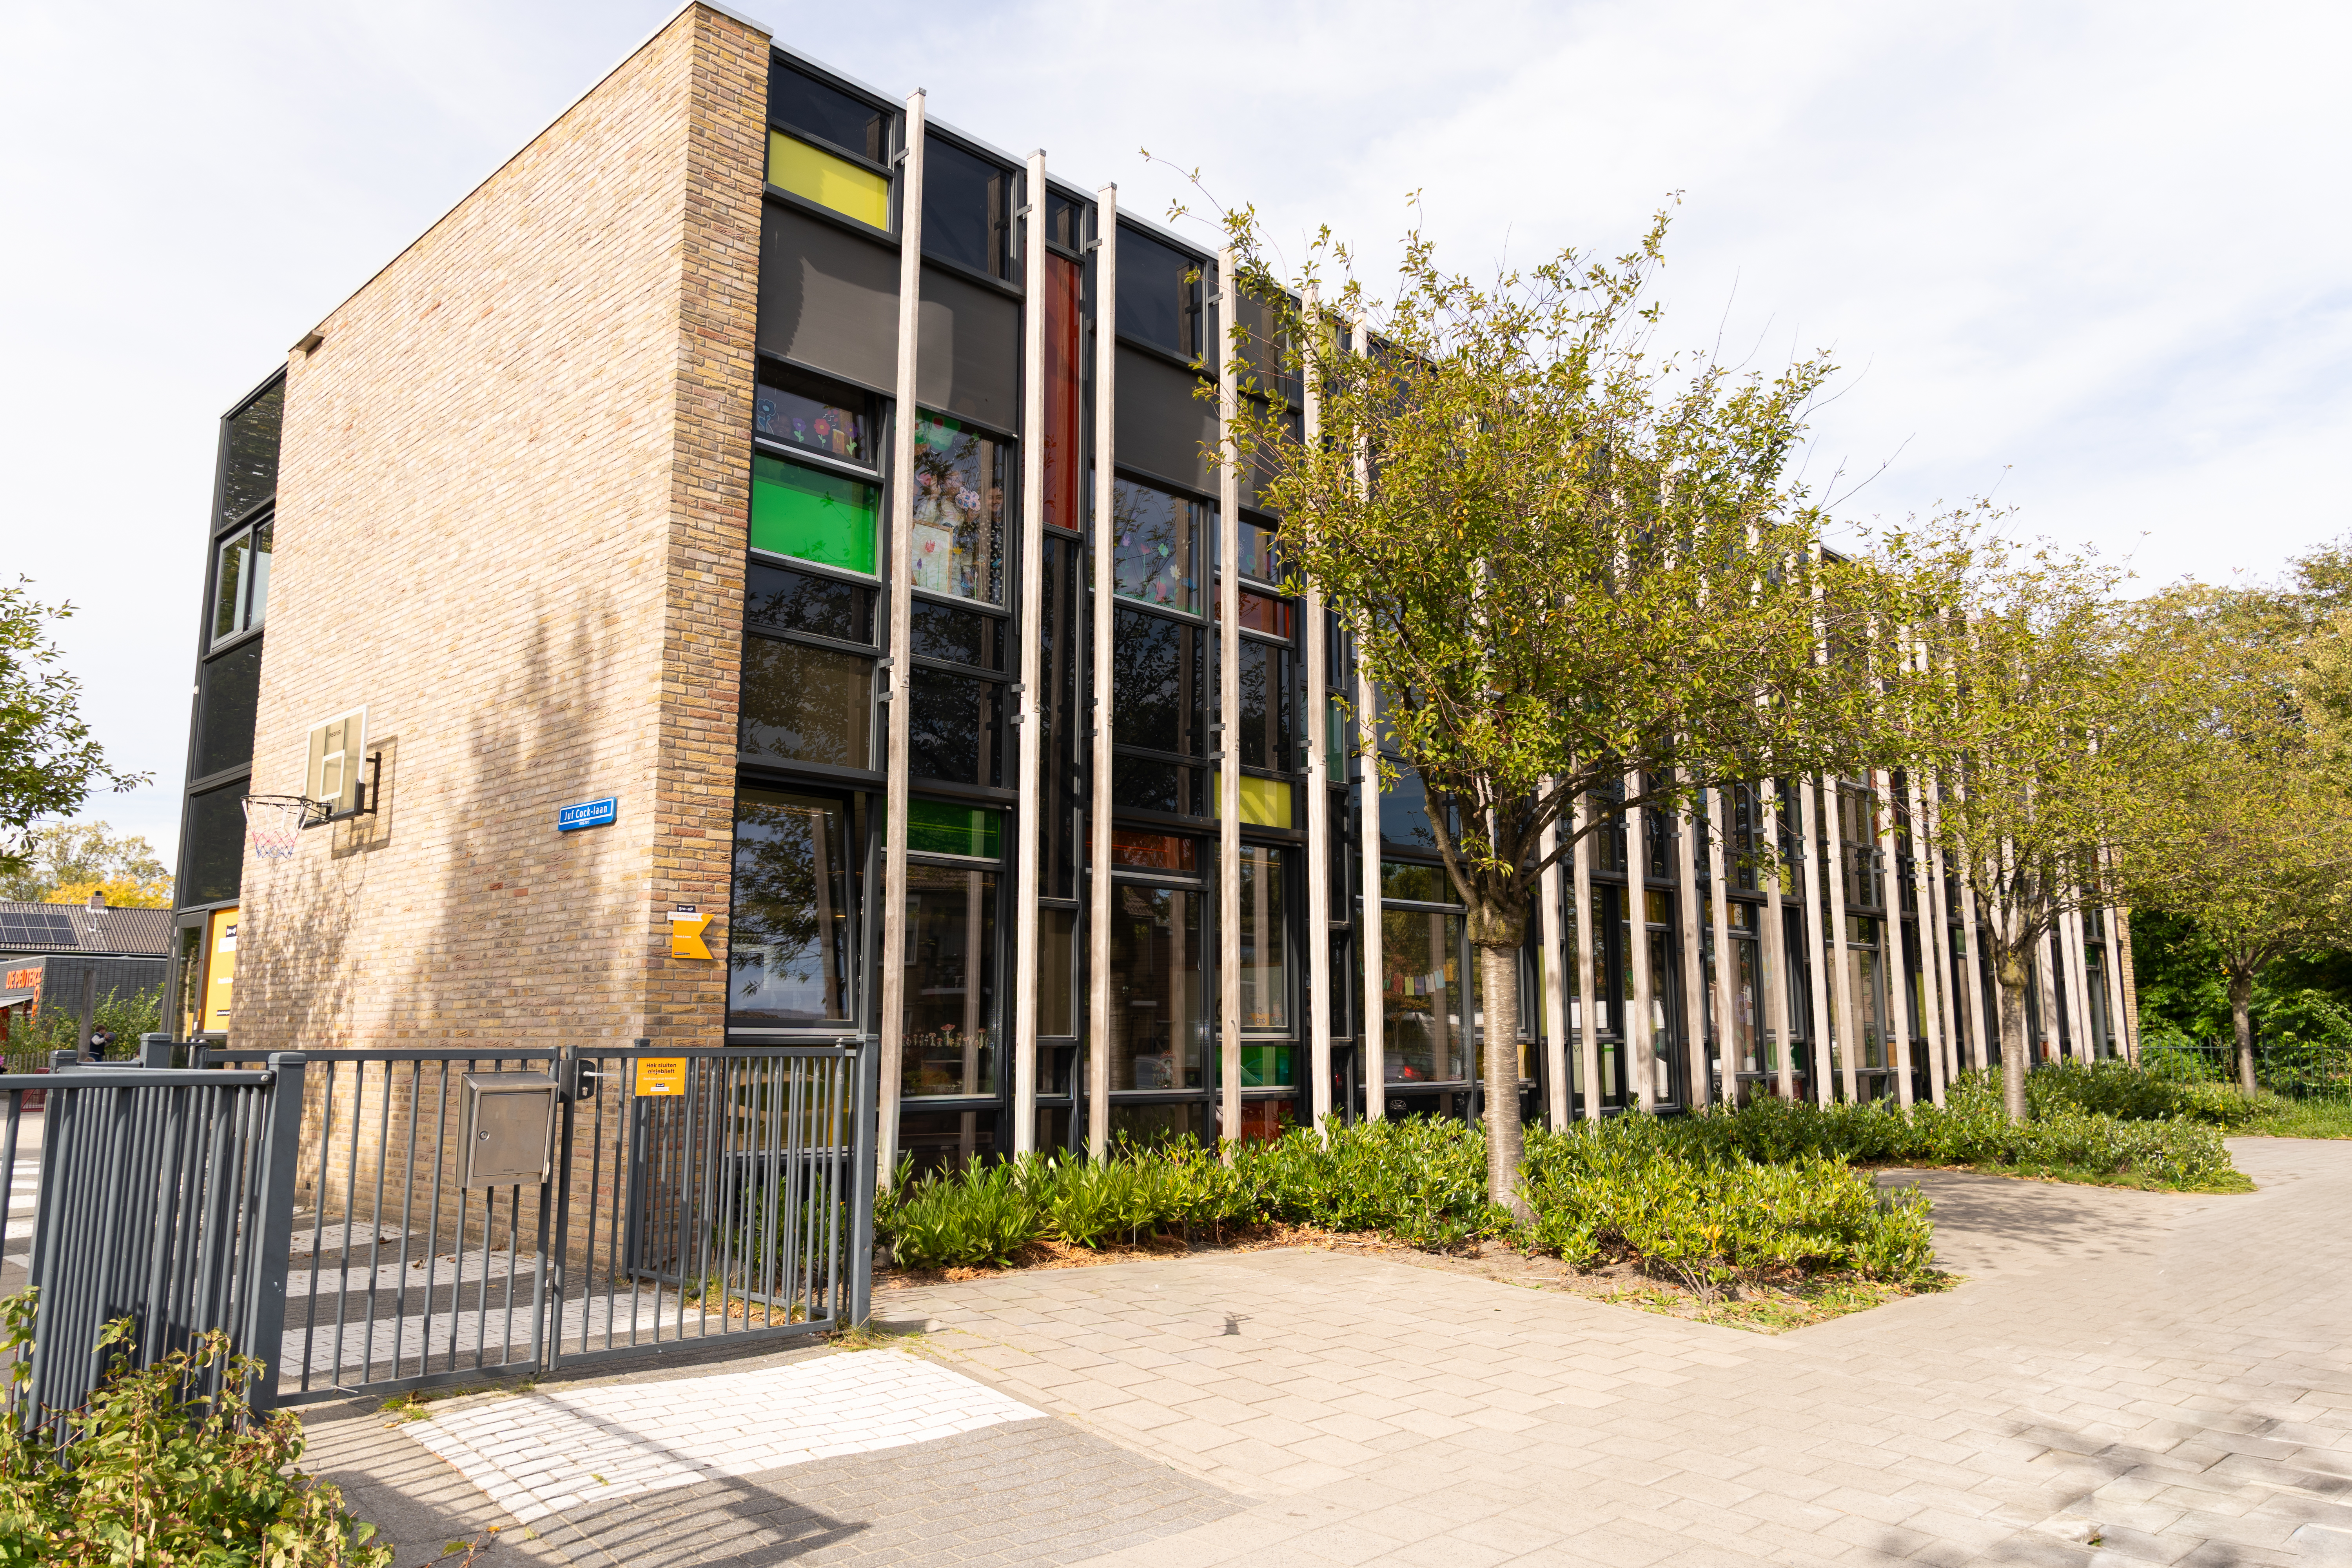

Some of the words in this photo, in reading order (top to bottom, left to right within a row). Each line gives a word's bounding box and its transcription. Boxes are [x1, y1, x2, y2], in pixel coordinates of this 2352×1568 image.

[564, 809, 574, 821] Juf
[575, 805, 608, 818] Cock-laan
[5, 971, 16, 989] DE
[14, 968, 38, 989] PEUTER
